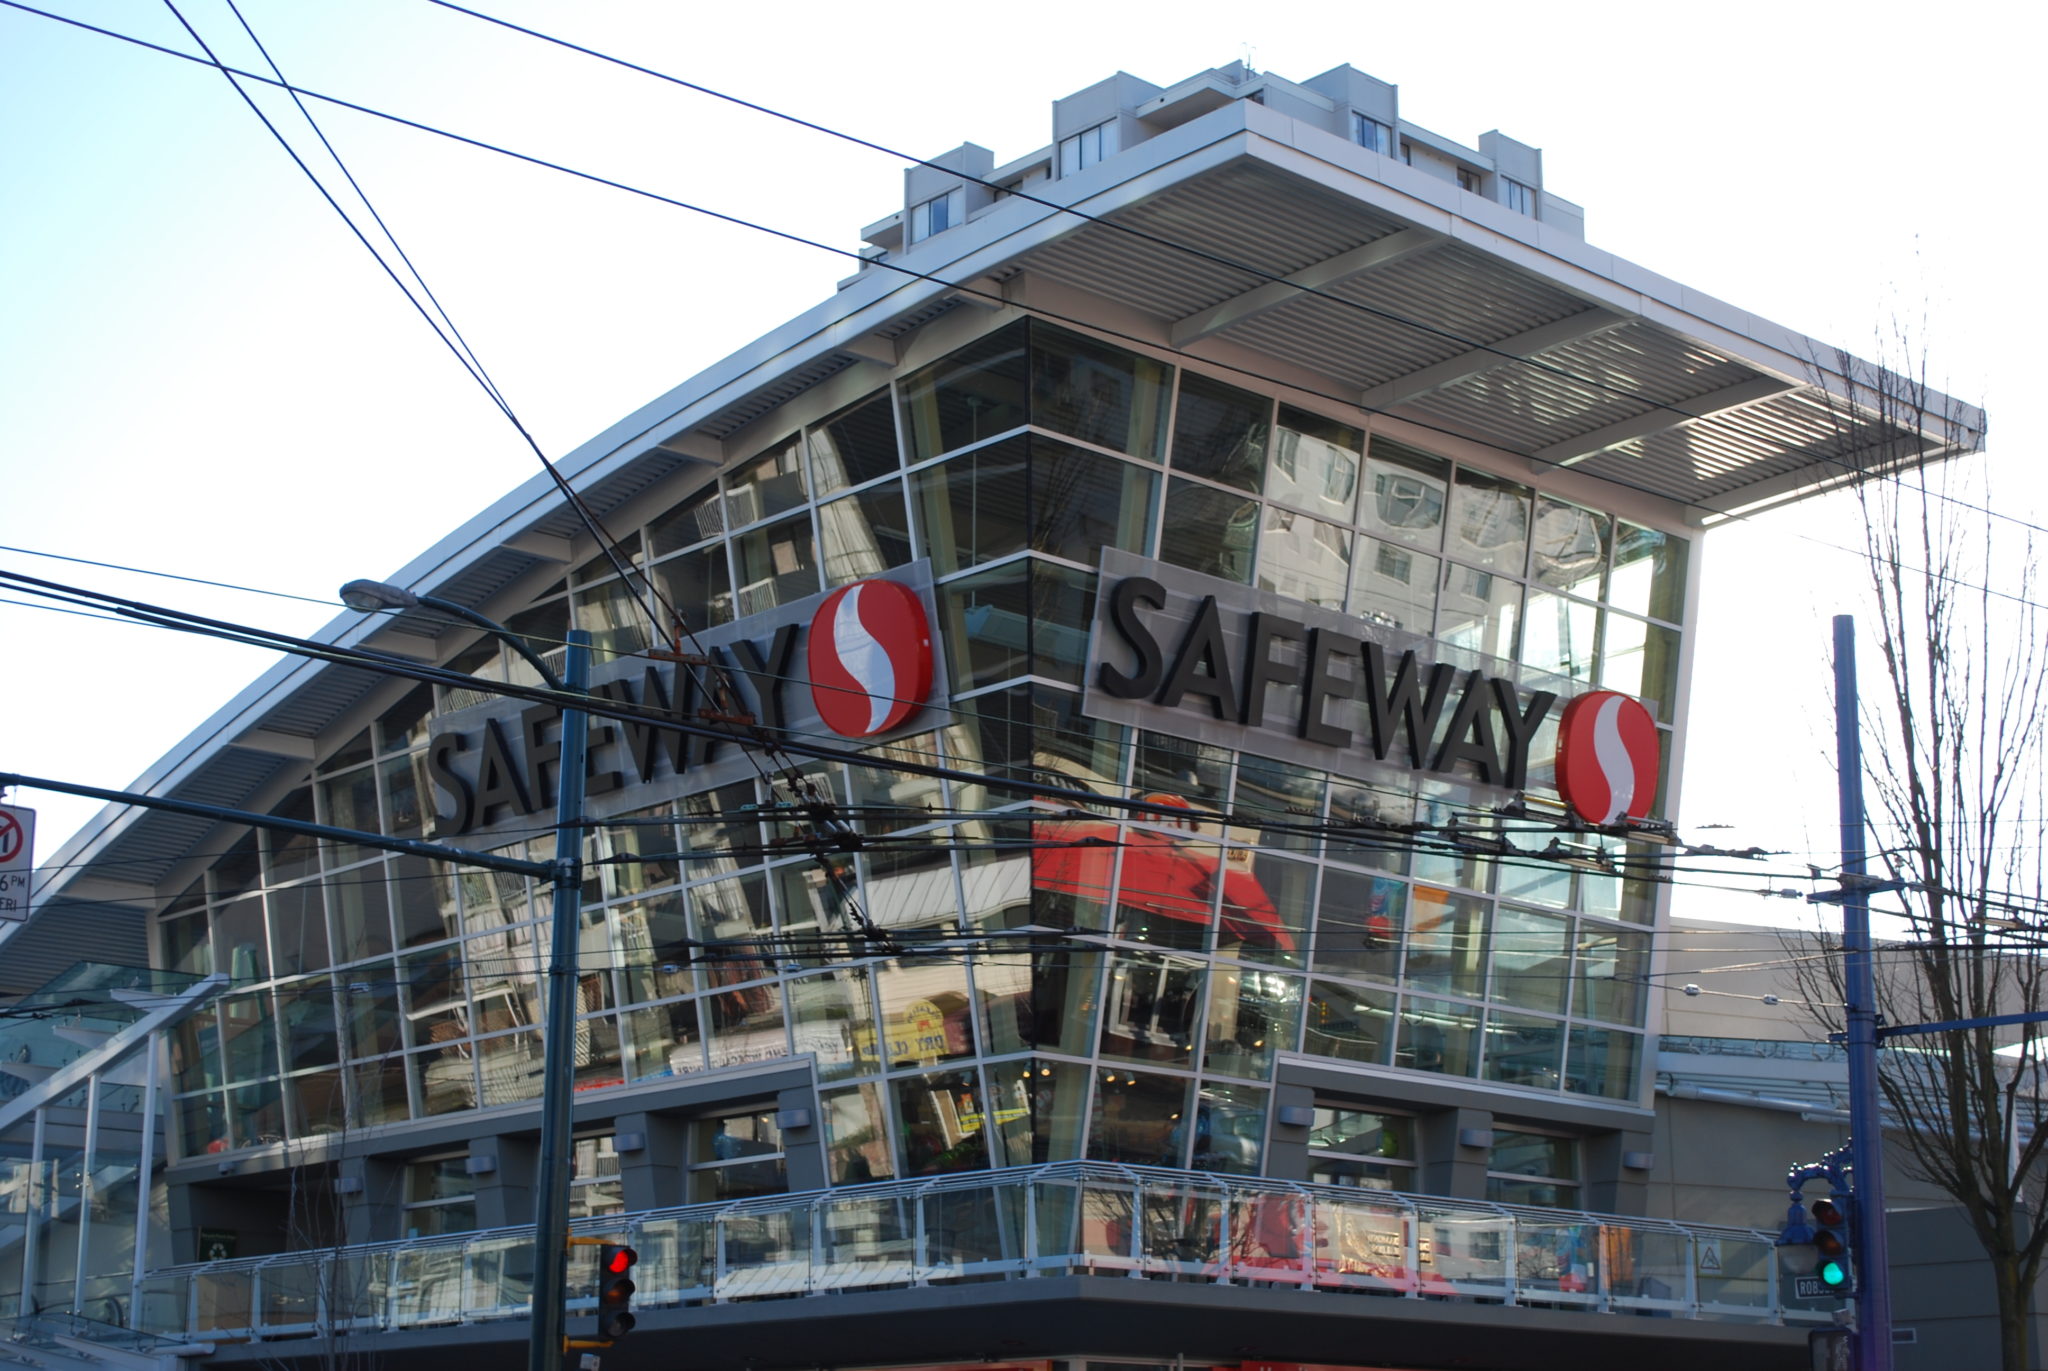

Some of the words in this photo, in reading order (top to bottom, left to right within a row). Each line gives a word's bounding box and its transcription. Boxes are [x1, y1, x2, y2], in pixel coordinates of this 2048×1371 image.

[427, 623, 800, 837] SAFEWAY
[1100, 576, 1557, 790] SAFEWAY
[11, 875, 25, 888] PM
